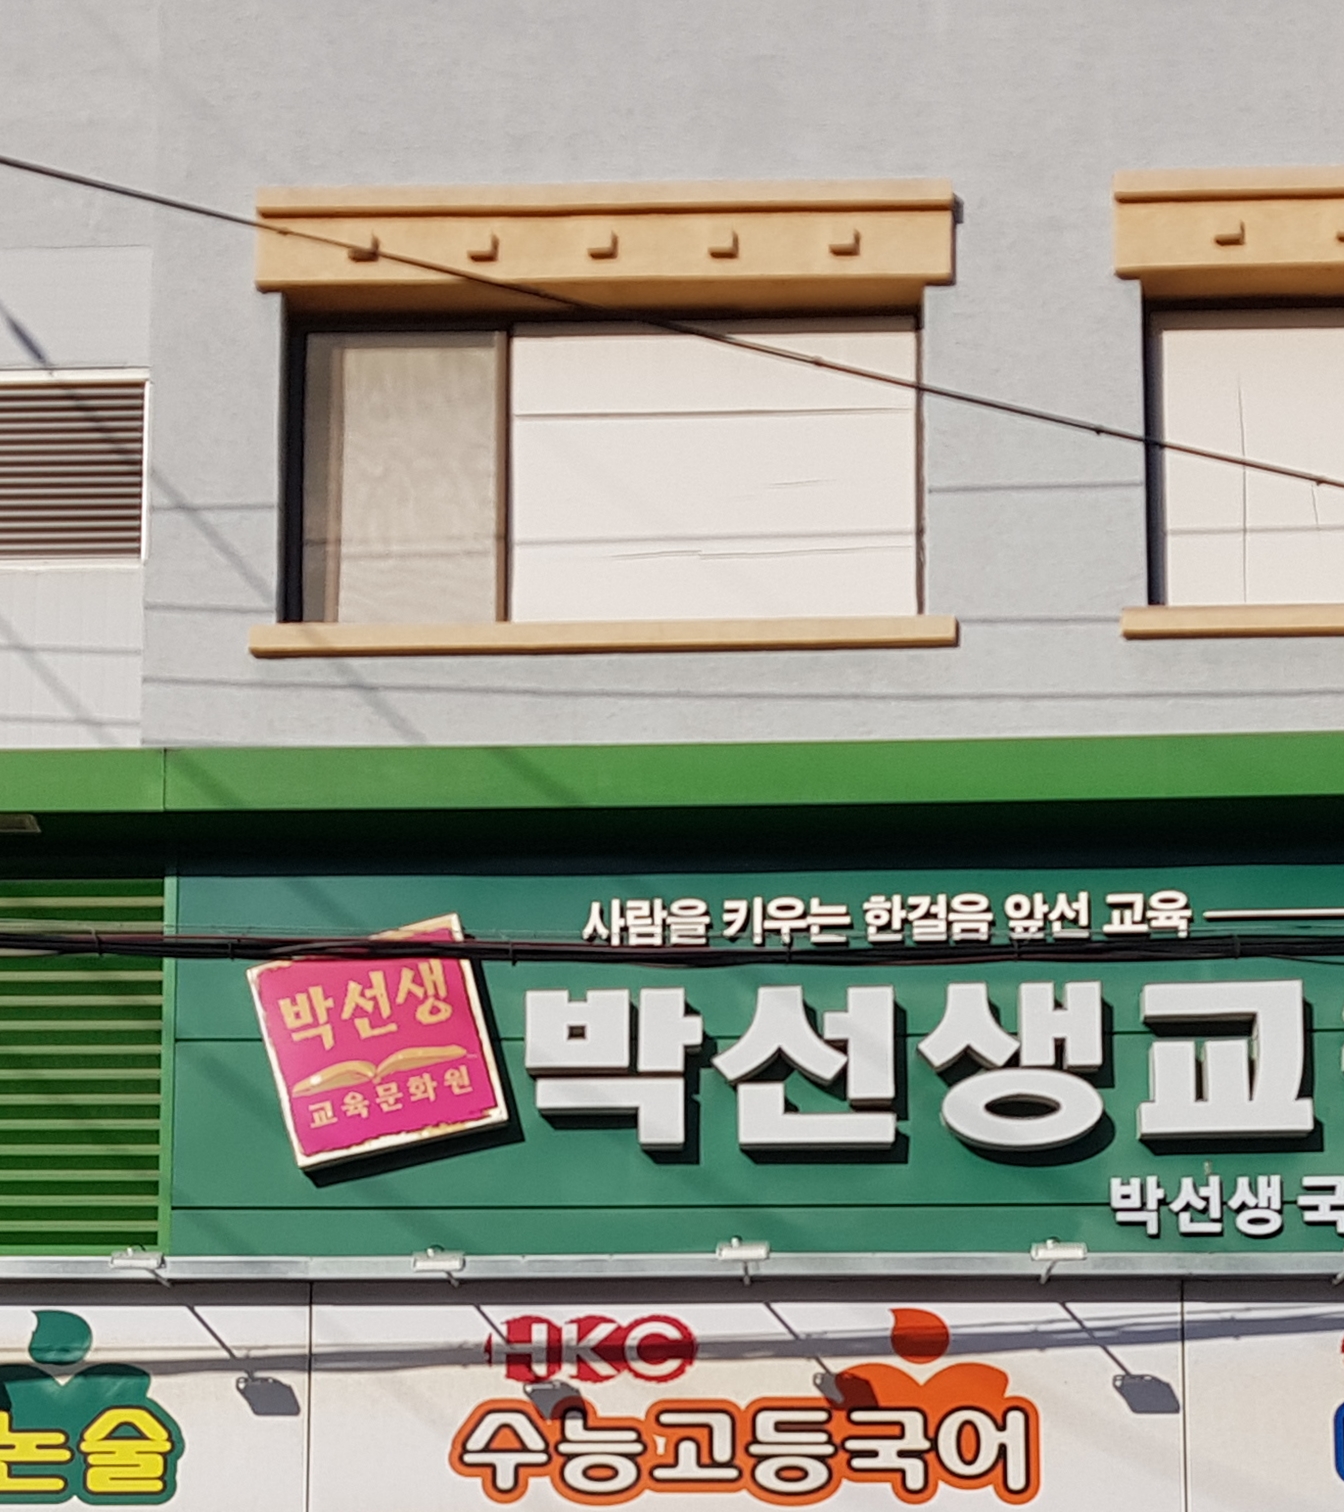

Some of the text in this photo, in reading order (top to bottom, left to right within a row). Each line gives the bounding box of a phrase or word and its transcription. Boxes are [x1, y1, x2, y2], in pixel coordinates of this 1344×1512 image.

[581, 890, 1192, 946] 사람을 키우는 한걸음 앞선 교육
[277, 957, 454, 1051] 박선생
[306, 1064, 475, 1129] 교육문화원
[1110, 1174, 1284, 1235] 박선생
[484, 1321, 695, 1377] HKC
[461, 1407, 1031, 1495] 수능고등국어
